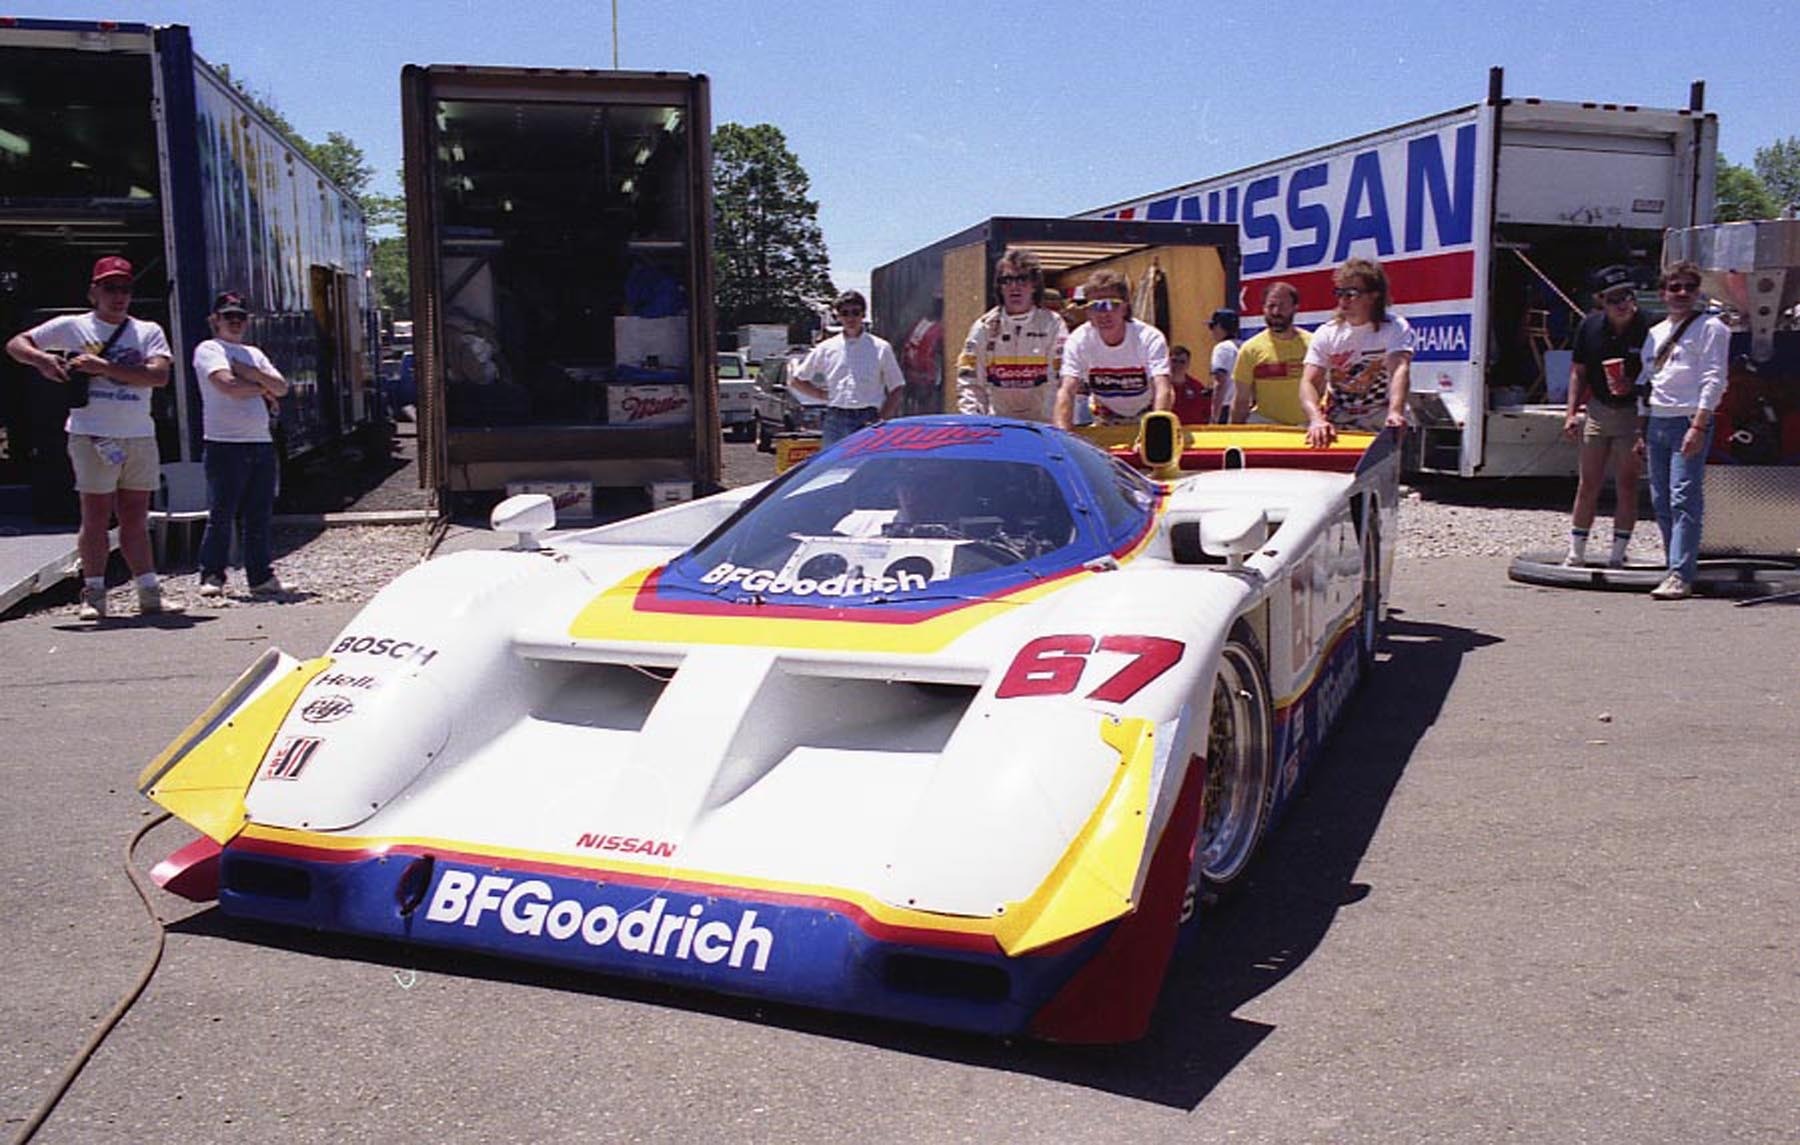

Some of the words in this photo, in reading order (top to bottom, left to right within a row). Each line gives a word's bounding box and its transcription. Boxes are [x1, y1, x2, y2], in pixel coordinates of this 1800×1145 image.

[1181, 124, 1477, 274] SSAN
[700, 563, 928, 598] BFGoodrich
[332, 636, 440, 666] BOSCH
[995, 634, 1187, 704] 67
[575, 833, 678, 858] NISSAN
[426, 870, 774, 972] BFGoodrich
